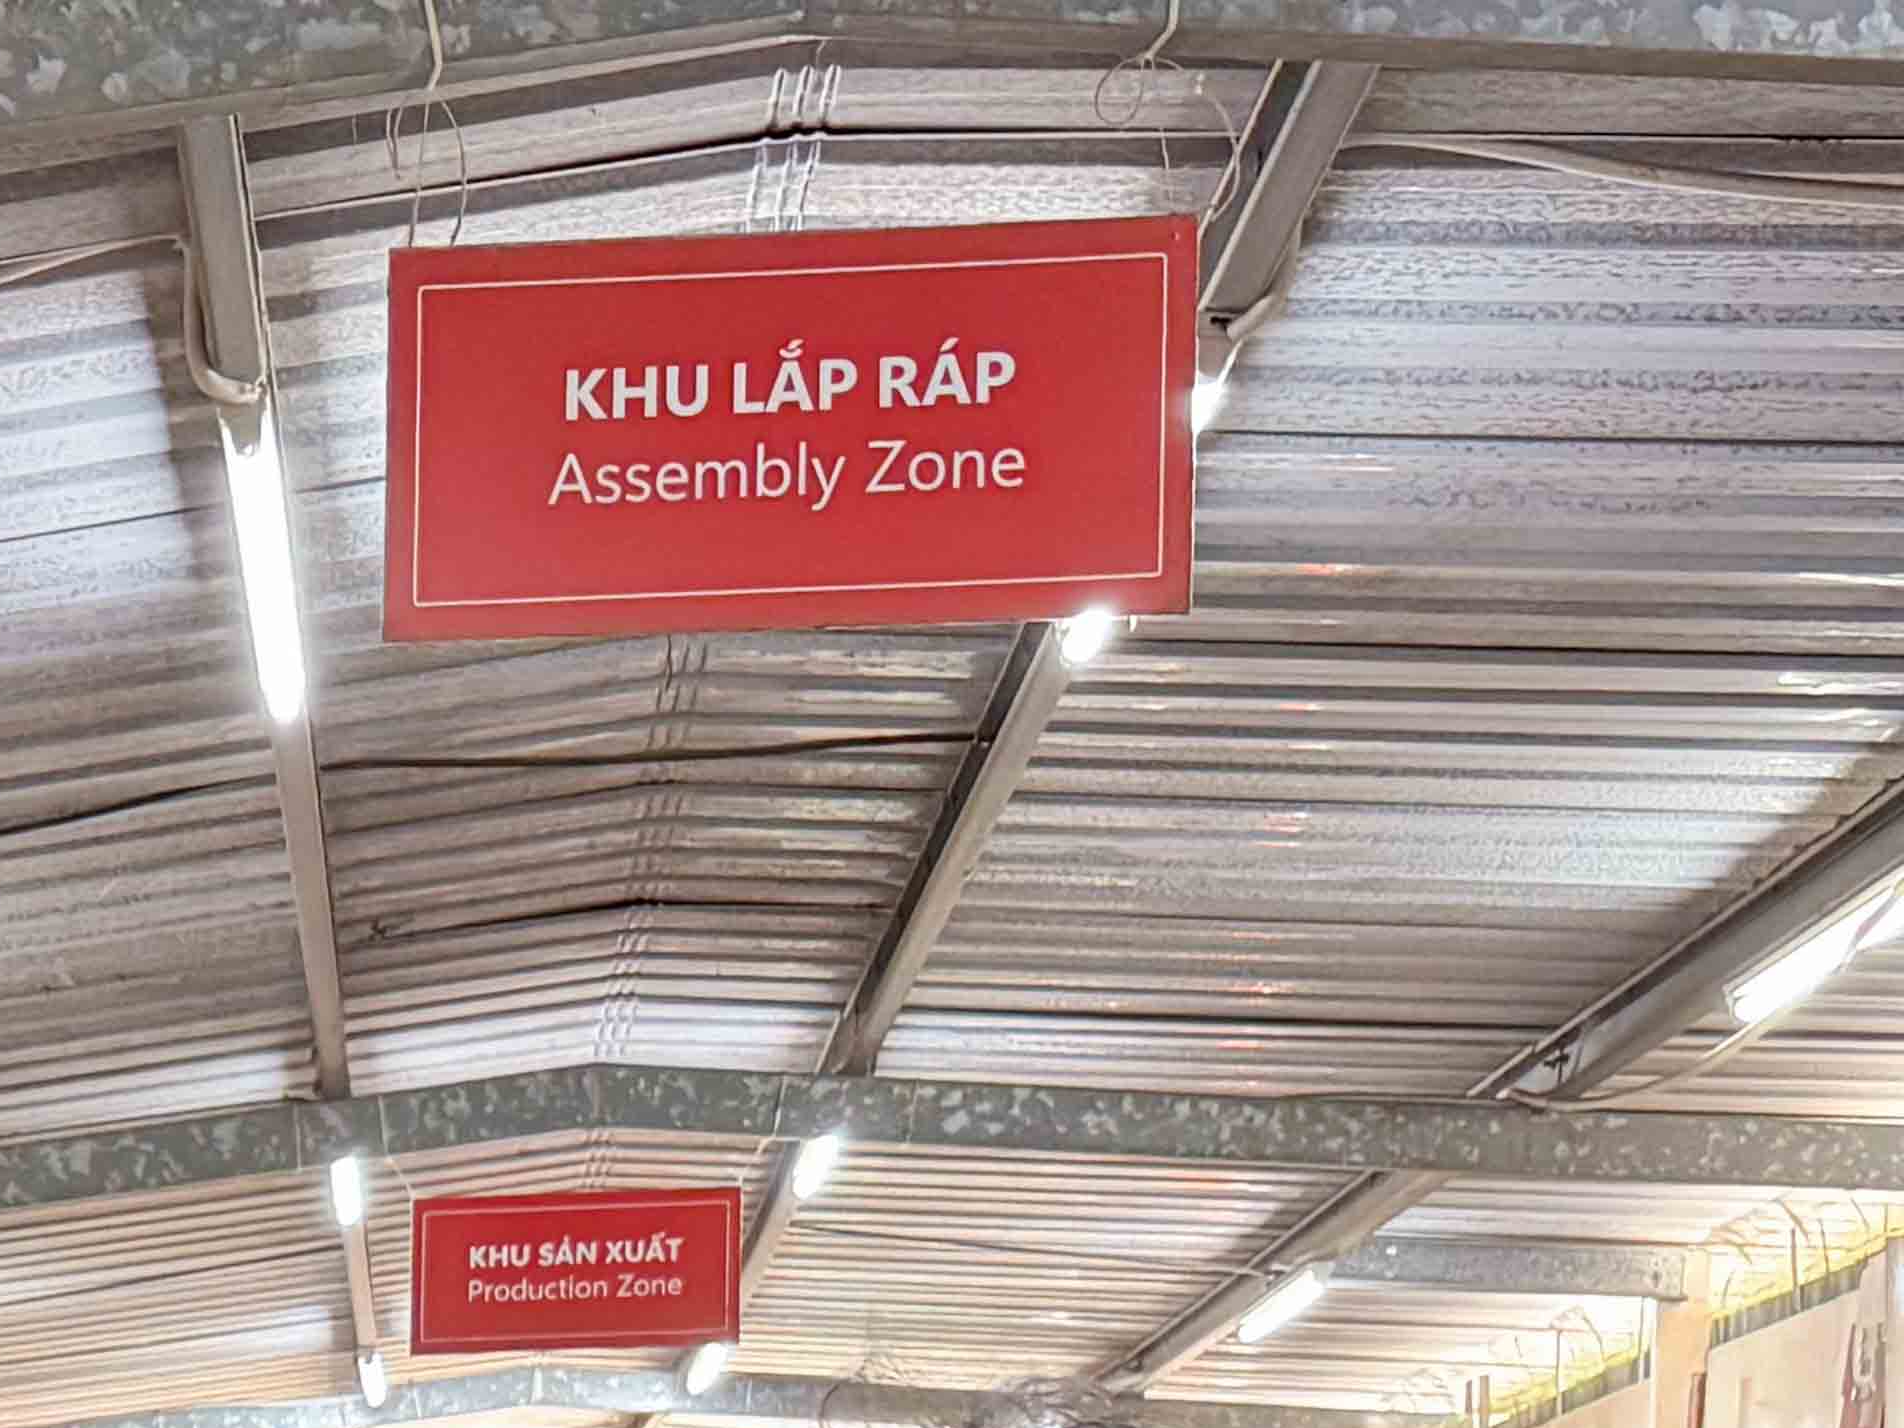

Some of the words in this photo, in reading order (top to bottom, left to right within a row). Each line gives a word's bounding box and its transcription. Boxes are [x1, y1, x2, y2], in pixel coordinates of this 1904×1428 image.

[564, 365, 710, 421] KHU
[733, 338, 859, 416] LẮP
[879, 336, 1018, 409] RÁP
[548, 440, 847, 512] Assembly
[866, 438, 1026, 494] Zone
[469, 1244, 531, 1269] KHU
[539, 1234, 598, 1267] SẢN
[605, 1231, 685, 1264] XUẤT
[468, 1275, 609, 1304] Production
[616, 1272, 683, 1298] Zone
